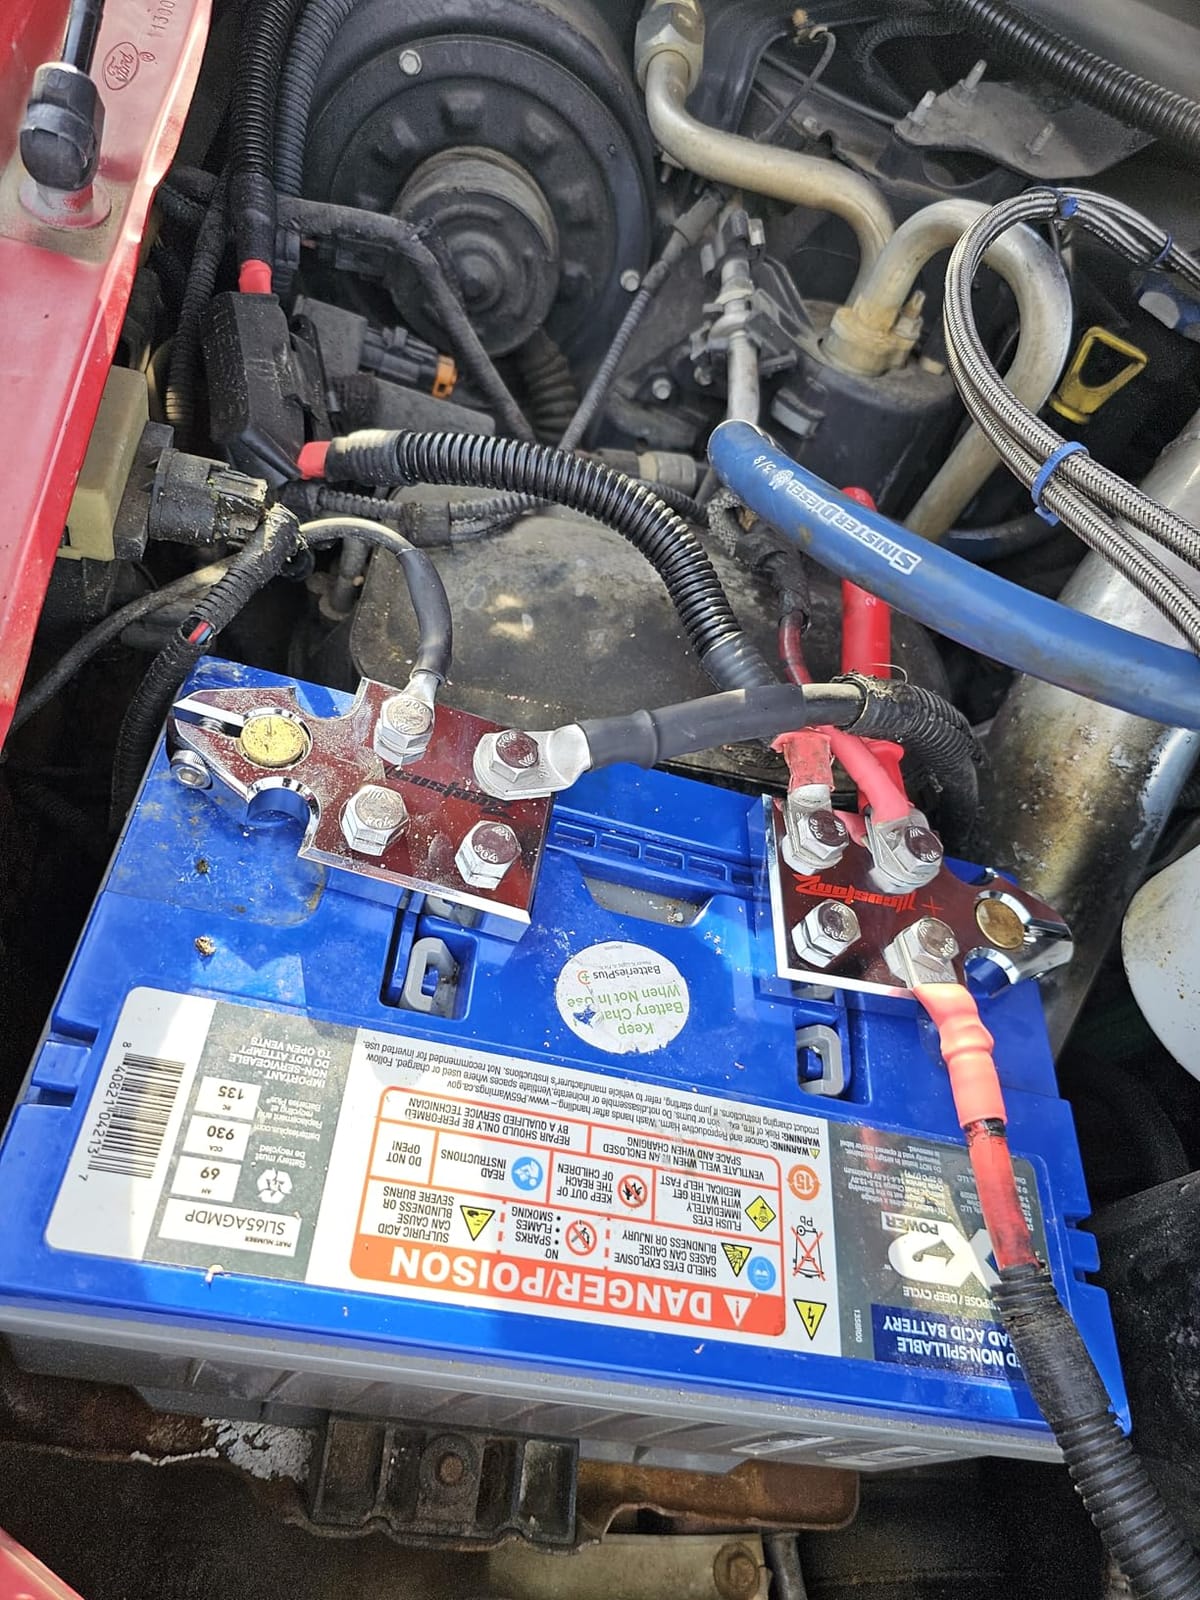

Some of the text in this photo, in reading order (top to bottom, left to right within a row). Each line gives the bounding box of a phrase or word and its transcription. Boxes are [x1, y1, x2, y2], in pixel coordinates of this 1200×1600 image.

[753, 452, 776, 473] 3/8
[592, 965, 660, 980] BatteriesPlus
[598, 993, 609, 1004] In
[613, 990, 637, 1003] Not
[640, 984, 680, 998] When
[635, 1001, 683, 1014] Battery
[617, 1022, 653, 1035] Keep
[238, 1043, 329, 1068] DO NOT ATTEMPT
[249, 1036, 331, 1058] TO OPEN VENTS
[227, 1052, 327, 1078] NON-SERVICEABLE
[102, 1064, 126, 1105] 40821
[263, 1069, 325, 1088] IMPORTANT
[217, 1084, 245, 1100] 135
[407, 1096, 569, 1134] BY A QUALIFIED SERVICE TECHNICIAN
[86, 1110, 111, 1154] 04213
[205, 1123, 236, 1140] 930
[403, 1107, 570, 1145] REPAIR SHOULD ONLY BE PERFORMED
[390, 1140, 421, 1155] OPEN!
[602, 1143, 646, 1160] ENCLOSED
[626, 1135, 742, 1166] SPACE AND WHEN CHARGING
[385, 1150, 422, 1166] DO NOT
[439, 1148, 506, 1169] INSTRUCTIONS
[648, 1151, 660, 1163] AN
[672, 1155, 697, 1169] WHEN
[198, 1165, 221, 1180] 69
[480, 1166, 505, 1180] READ
[556, 1162, 613, 1181] OF CHILDREN
[701, 1160, 720, 1173] WELL
[722, 1164, 764, 1181] VENTILATE
[77, 1173, 88, 1181] 7
[564, 1174, 612, 1192] THE REACH
[660, 1174, 741, 1197] MEDICAL HELP FAST
[795, 1172, 812, 1191] 15
[382, 1185, 454, 1206] SEVERE BURNS
[555, 1185, 612, 1204] KEEP OUT OF
[671, 1187, 741, 1208] WITH WATER GET
[382, 1197, 452, 1218] BLINDNESS OR
[510, 1205, 553, 1222] SMOKING
[686, 1201, 741, 1219] IMMEDIATELY
[183, 1207, 286, 1235] SLI65AGMDP
[396, 1212, 451, 1230] CAN CAUSE
[515, 1218, 552, 1234] FLAMES
[692, 1213, 741, 1231] FLUSH EYES
[799, 1215, 813, 1226] Pb
[884, 1214, 939, 1235] POWER
[376, 1222, 449, 1243] SULFURIC ACID
[514, 1230, 551, 1246] SPARKS
[621, 1229, 716, 1253] BLINDNESS OR INJURY
[544, 1247, 558, 1259] NO
[638, 1243, 716, 1265] GASES CAN CAUSE
[613, 1251, 716, 1277] SHIELD EYES EXPLOSIVE
[389, 1246, 711, 1321] DANGER/POISON
[902, 1285, 932, 1300] CYCLE
[932, 1290, 957, 1304] DEEP
[881, 1314, 947, 1338] BATTERY
[949, 1323, 985, 1343] ACID
[896, 1335, 1005, 1365] NON-SPILLABLE
